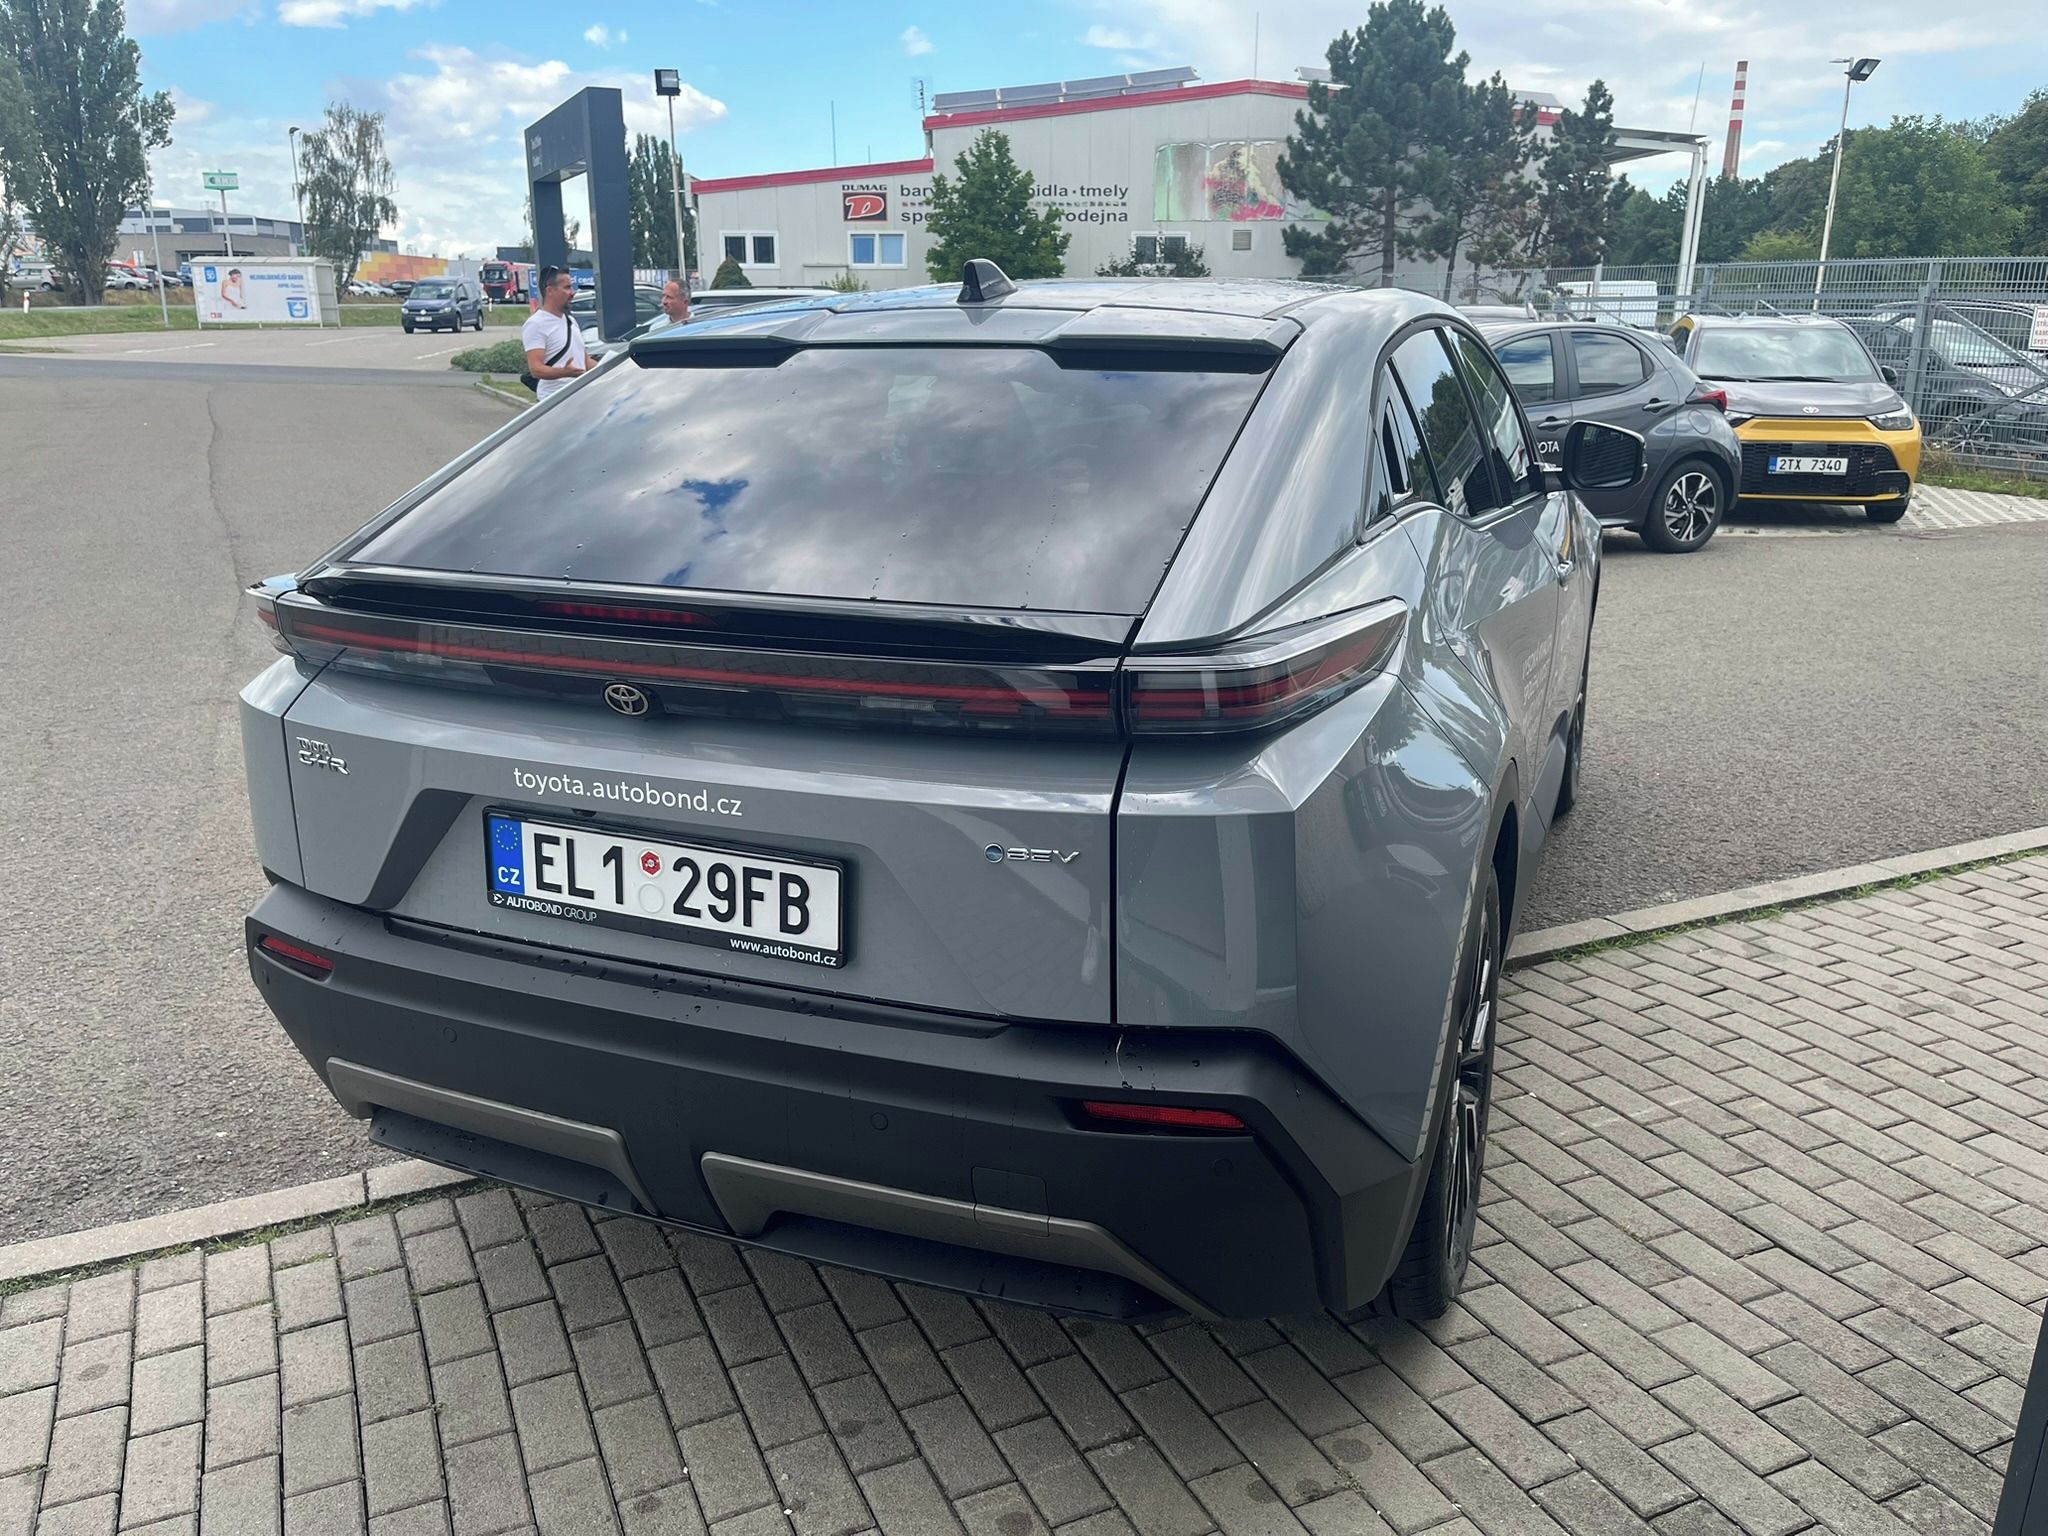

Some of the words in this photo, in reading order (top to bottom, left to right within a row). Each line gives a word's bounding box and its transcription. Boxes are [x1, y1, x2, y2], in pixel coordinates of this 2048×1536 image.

[1080, 184, 1128, 199] tmely
[1537, 441, 1560, 454] OTA
[1779, 459, 1801, 470] 2TX
[1811, 459, 1842, 471] 7340
[513, 767, 743, 817] toyota.autobond.cz
[498, 866, 521, 886] CZ
[533, 832, 624, 905] EL1
[672, 856, 810, 935] 29FB
[506, 896, 563, 916] AUTOBOND
[563, 906, 598, 922] GROUP
[730, 938, 837, 966] www.autobond.cz
